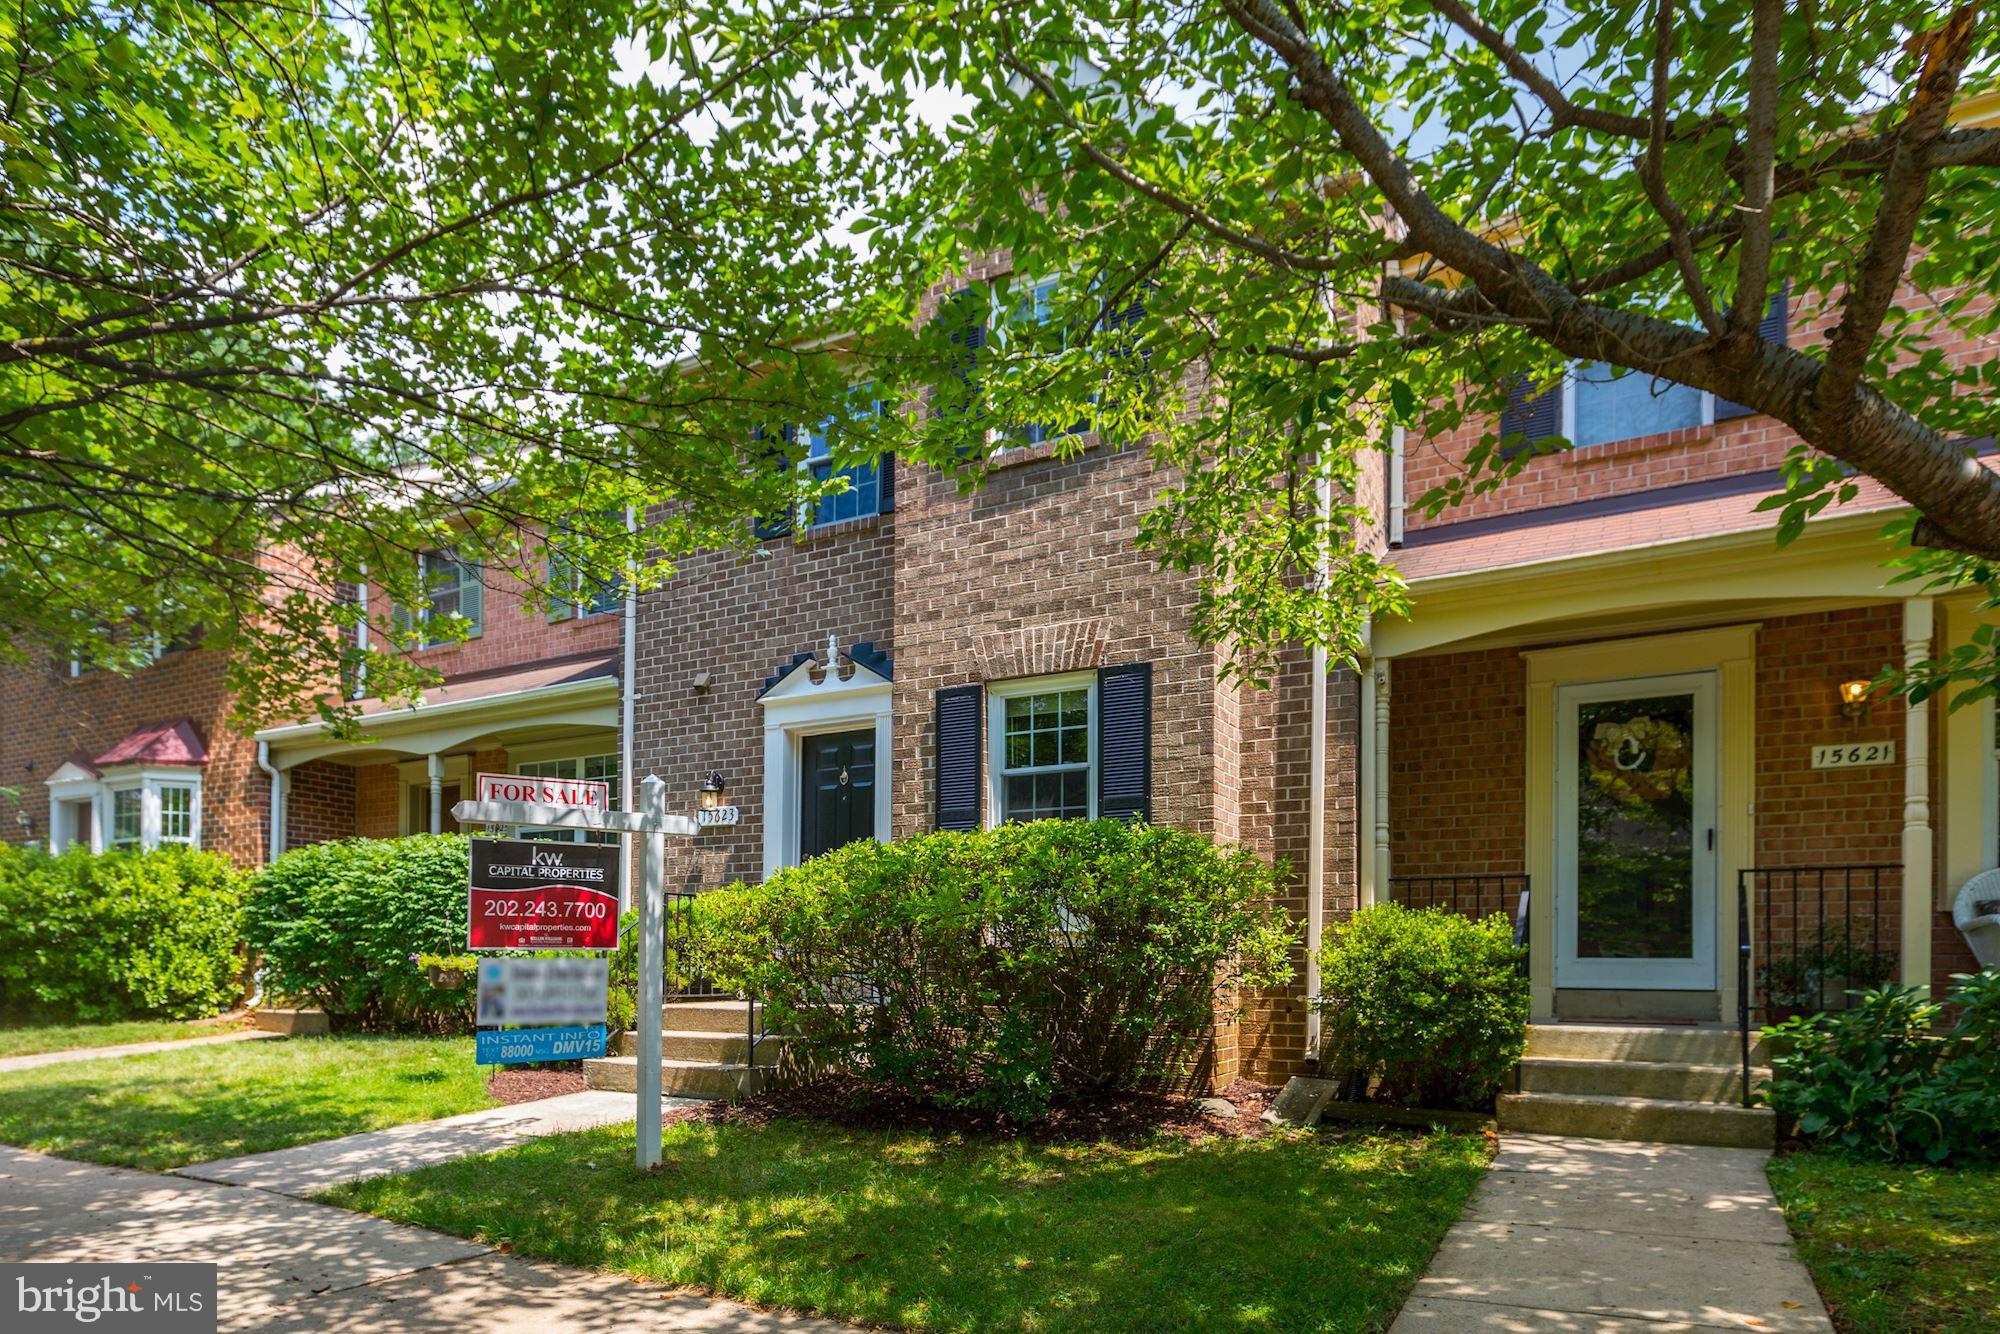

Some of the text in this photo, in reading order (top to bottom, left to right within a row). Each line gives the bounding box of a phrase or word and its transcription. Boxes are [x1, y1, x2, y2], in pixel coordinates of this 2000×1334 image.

[1819, 744, 1888, 765] 15621
[490, 783, 598, 807] FOR SALE
[702, 808, 734, 822] 15623
[488, 865, 604, 880] CAPITAL PROPERTIES
[484, 899, 607, 919] 202.243.7700
[499, 922, 592, 933] kwcapitalproperties.com
[481, 1030, 601, 1045] INSTANT INFO
[500, 1044, 534, 1058] 88000
[552, 1039, 601, 1055] DMV15
